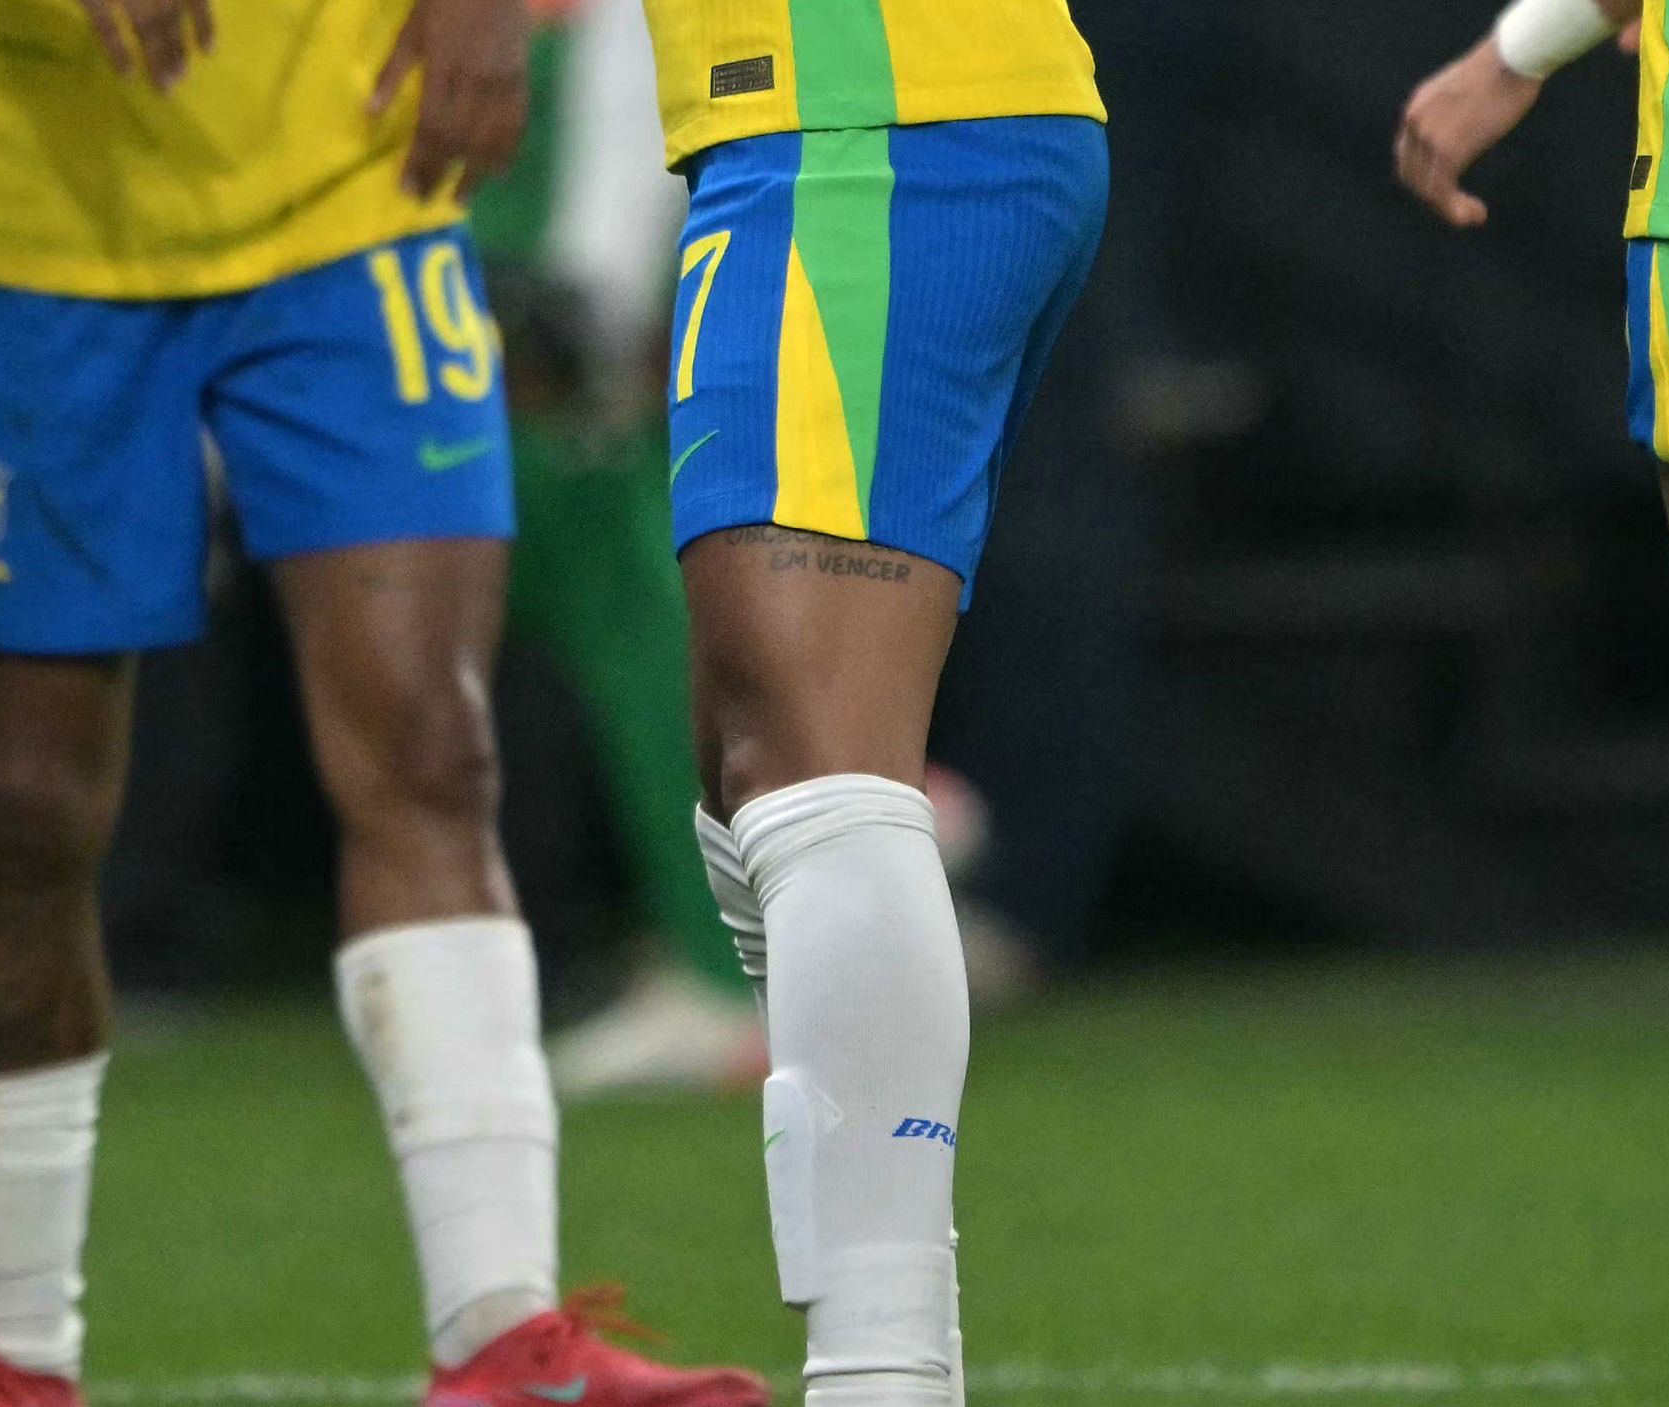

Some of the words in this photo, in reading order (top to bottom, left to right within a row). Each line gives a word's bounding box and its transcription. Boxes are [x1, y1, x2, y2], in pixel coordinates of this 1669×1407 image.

[369, 243, 503, 404] 19
[677, 230, 731, 404] 7
[770, 549, 807, 572] EM
[816, 551, 911, 584] VENCER
